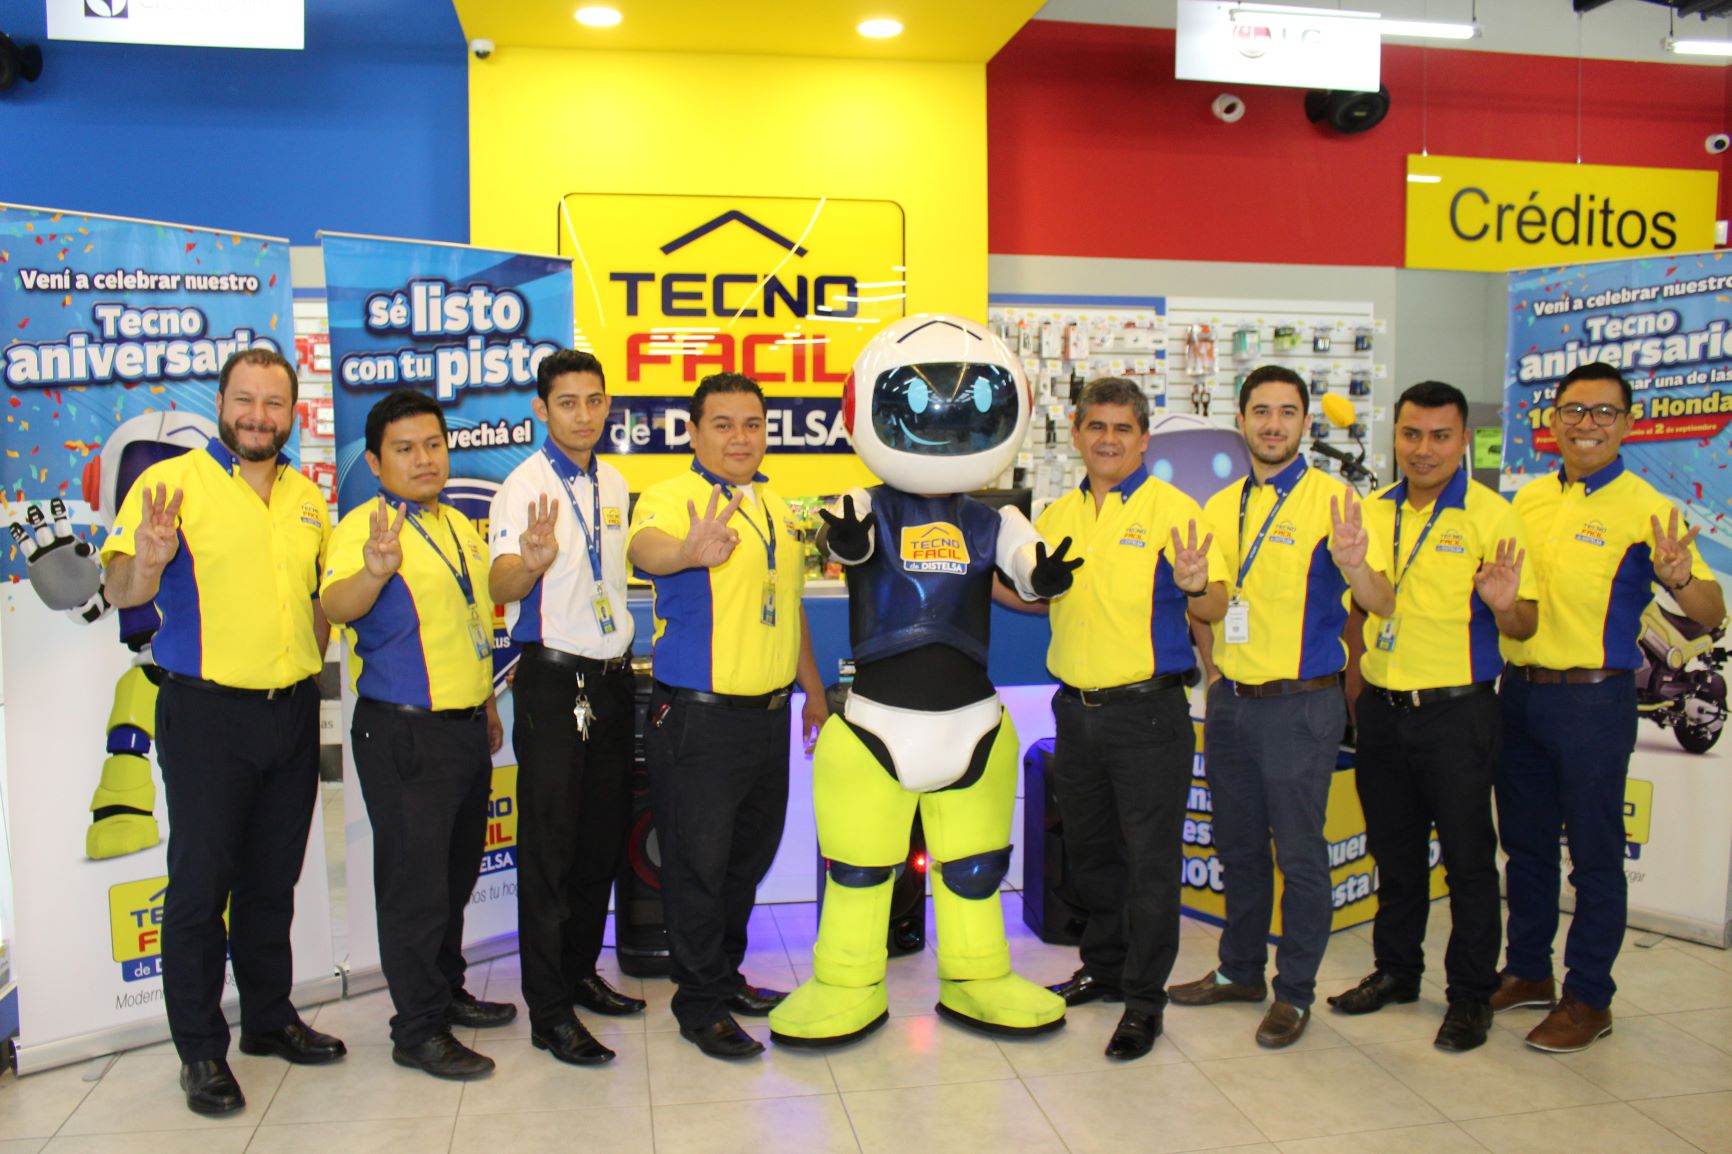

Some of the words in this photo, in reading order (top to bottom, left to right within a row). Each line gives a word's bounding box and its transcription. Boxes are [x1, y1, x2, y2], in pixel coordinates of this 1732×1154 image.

[1449, 186, 1677, 250] Créditos
[20, 268, 70, 290] Vení
[75, 275, 89, 289] a
[93, 269, 180, 290] celebrar
[185, 275, 258, 292] nuestro
[369, 295, 408, 326] sé
[414, 284, 521, 333] listo
[609, 272, 858, 318] TECNO
[1534, 296, 1570, 316] Vení
[1573, 299, 1583, 310] a
[1587, 286, 1659, 309] celebrar
[97, 304, 201, 338] Tecno
[1586, 310, 1676, 341] Tecno
[345, 357, 394, 382] con
[401, 353, 432, 380] tu
[626, 333, 852, 383] FACIL
[1655, 374, 1683, 388] una
[1687, 369, 1706, 384] de
[448, 418, 509, 448] vechá
[513, 419, 531, 444] el
[610, 408, 651, 447] de
[1655, 423, 1664, 434] 2
[911, 538, 960, 550] TECNO
[913, 548, 962, 560] FACIL
[909, 562, 919, 570] de
[921, 562, 963, 572] DISTELSA
[134, 962, 150, 977] de
[115, 988, 164, 1009] Modern
